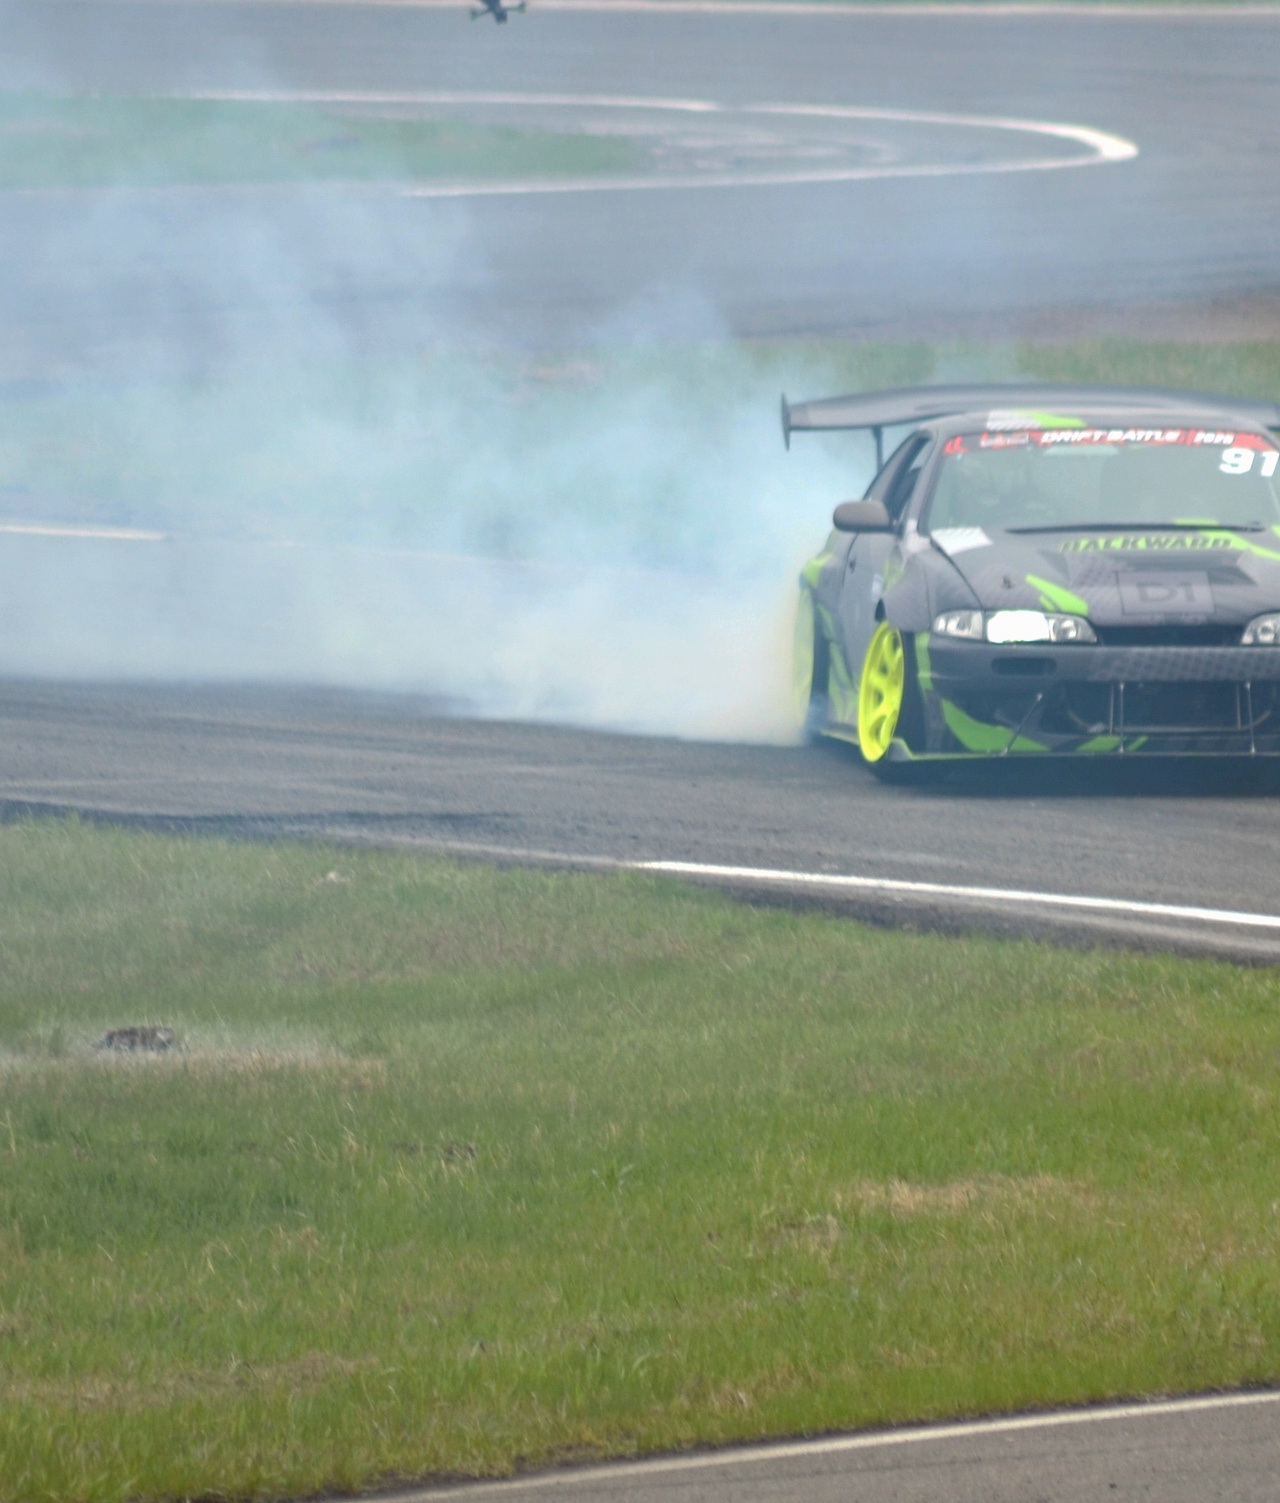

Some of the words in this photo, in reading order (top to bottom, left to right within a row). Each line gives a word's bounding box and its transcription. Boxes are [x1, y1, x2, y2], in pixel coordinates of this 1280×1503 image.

[1041, 430, 1107, 443] DRIFT
[1106, 430, 1181, 442] BATTLE
[1219, 447, 1280, 477] 91
[1060, 537, 1233, 552] BACKWARD
